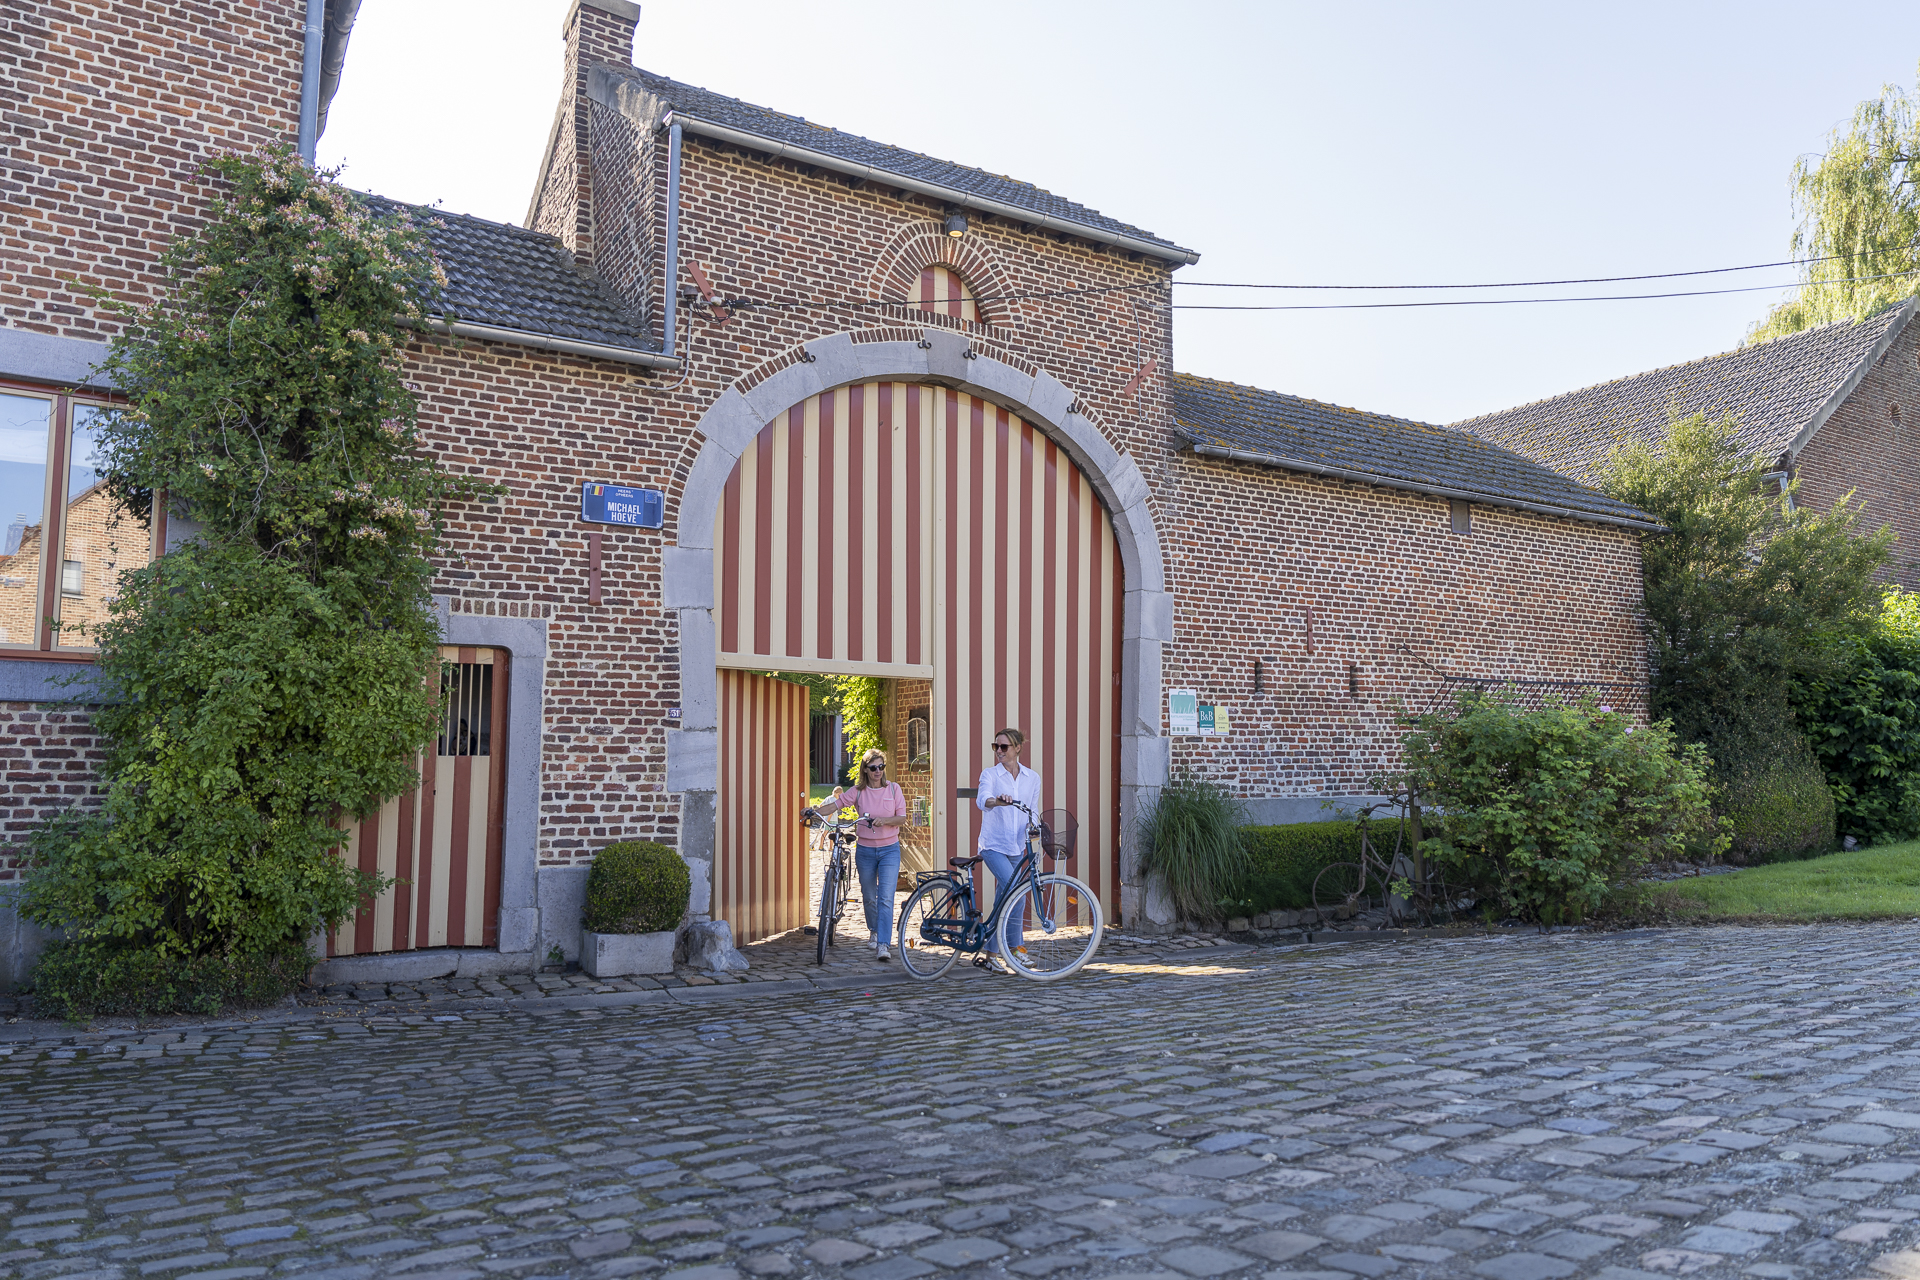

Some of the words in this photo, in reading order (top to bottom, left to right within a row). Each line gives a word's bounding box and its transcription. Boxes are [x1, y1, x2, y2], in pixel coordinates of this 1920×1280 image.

[607, 501, 642, 515] MICHAEL
[611, 511, 637, 524] HOEVE
[671, 709, 679, 717] 31
[1200, 710, 1214, 721] B&B
